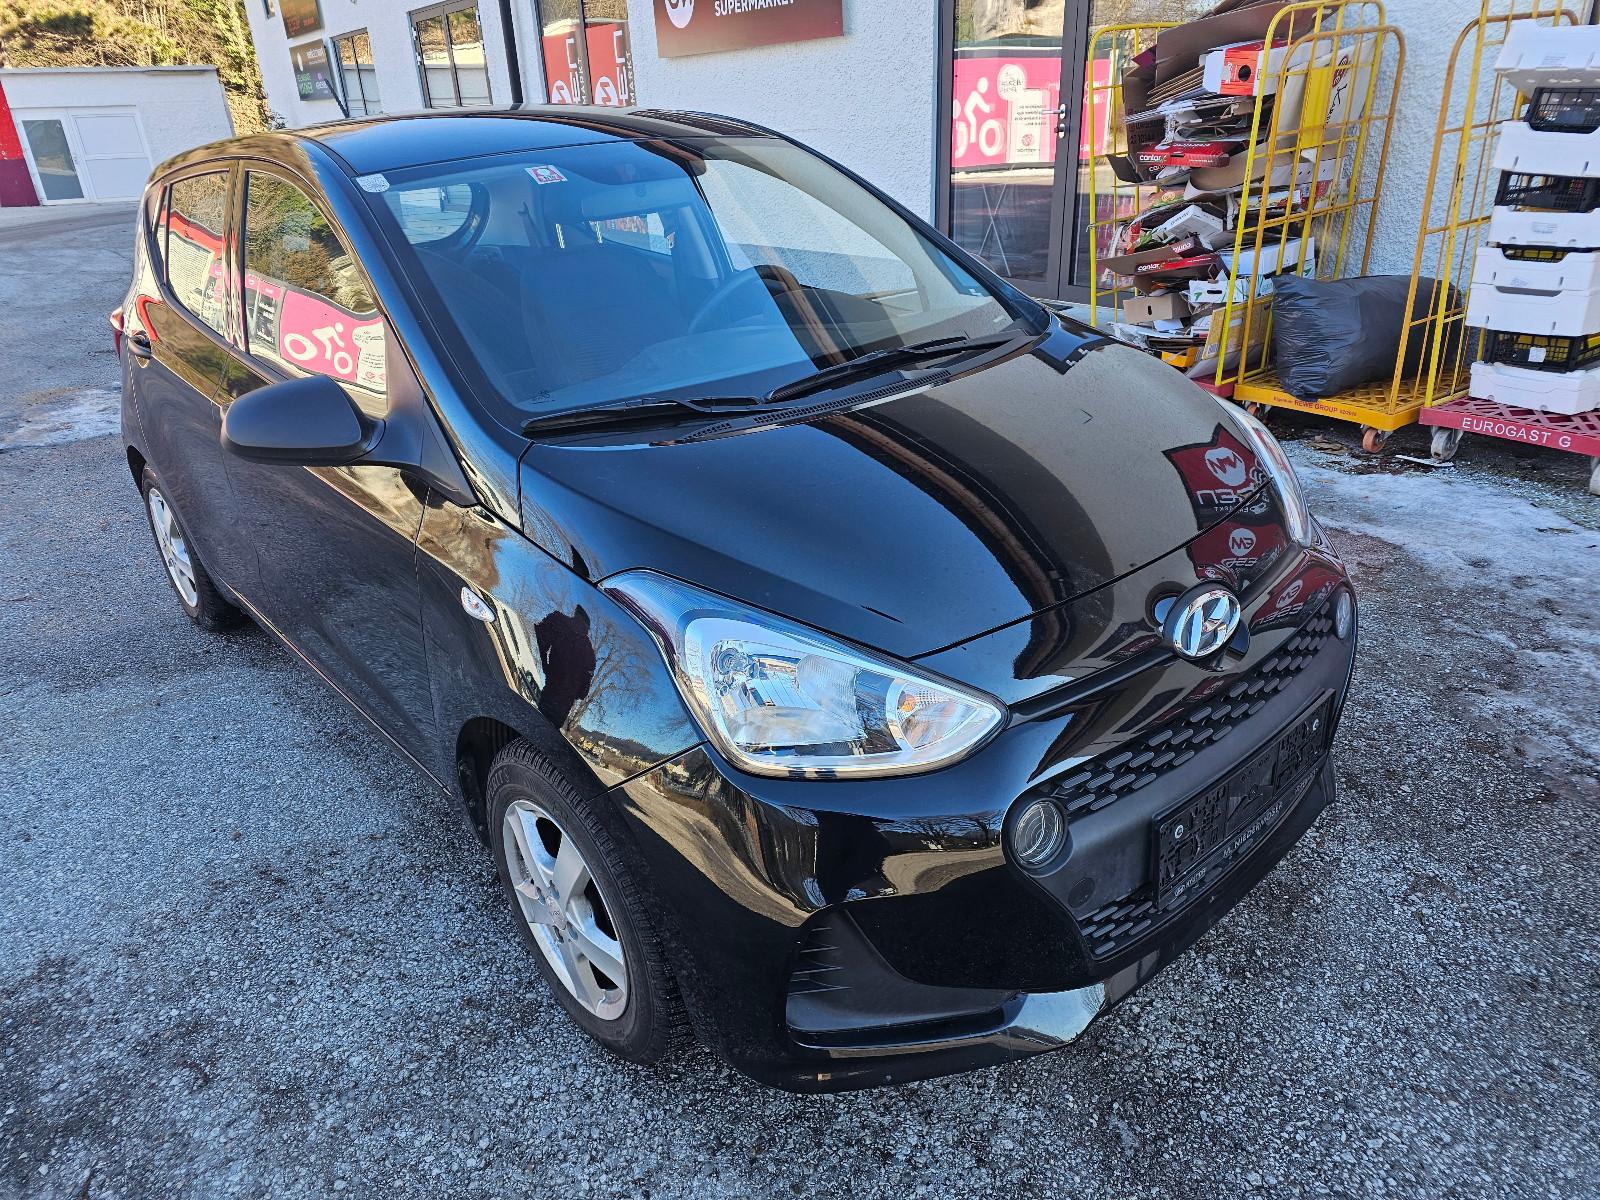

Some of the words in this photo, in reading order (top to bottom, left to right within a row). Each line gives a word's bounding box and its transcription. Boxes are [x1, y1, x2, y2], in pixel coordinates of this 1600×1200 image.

[714, 0, 794, 17] SUPERMAR
[1294, 400, 1313, 409] REWE
[1314, 403, 1338, 413] GROUP
[1462, 417, 1552, 444] EUROGAST
[1558, 435, 1572, 448] G
